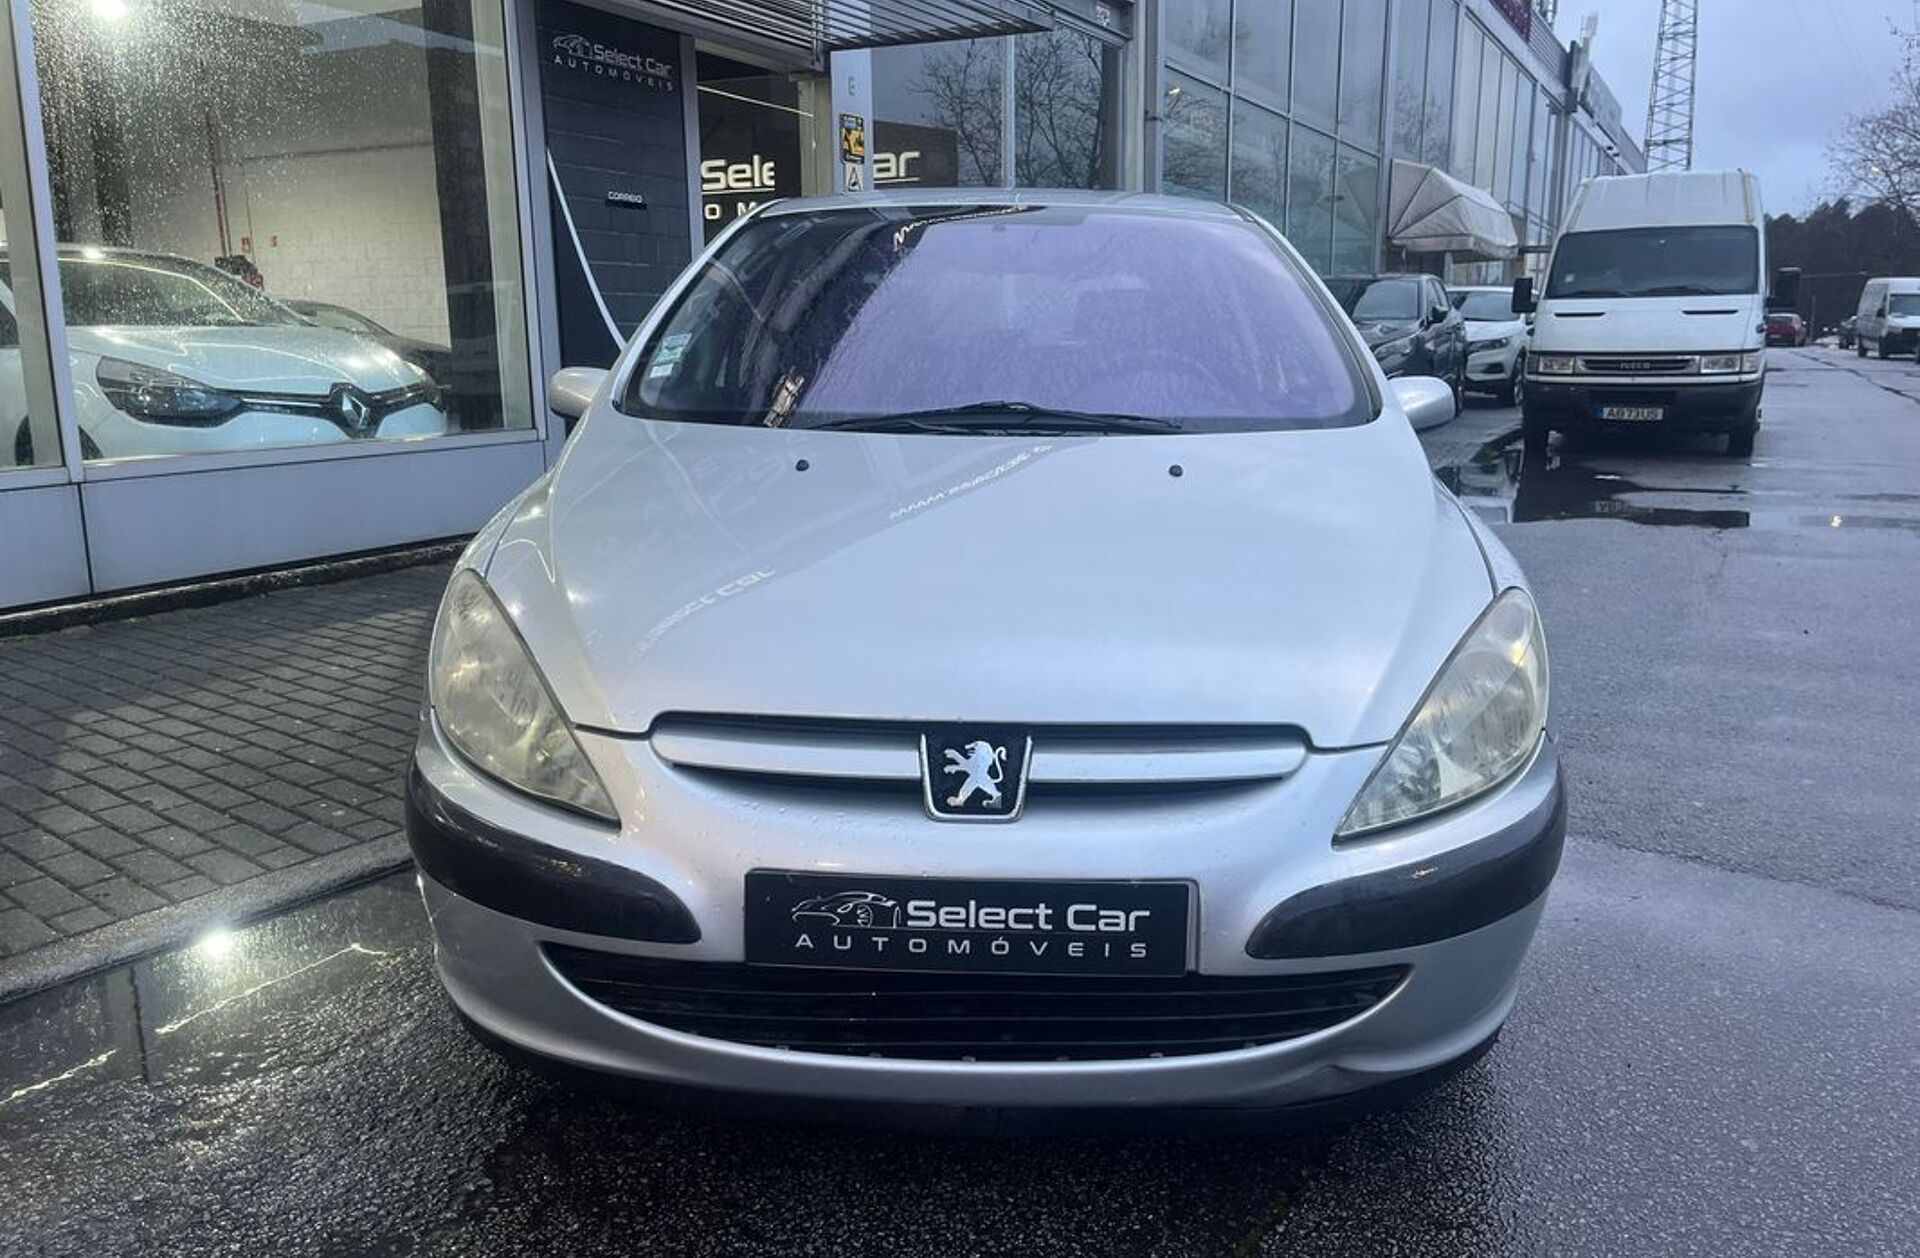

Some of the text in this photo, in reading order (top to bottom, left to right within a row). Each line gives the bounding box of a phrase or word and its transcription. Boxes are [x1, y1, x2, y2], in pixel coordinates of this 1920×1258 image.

[593, 44, 672, 77] Select Car
[907, 900, 1151, 932] Select Car
[795, 933, 1147, 959] AUTOMÓVEIS
